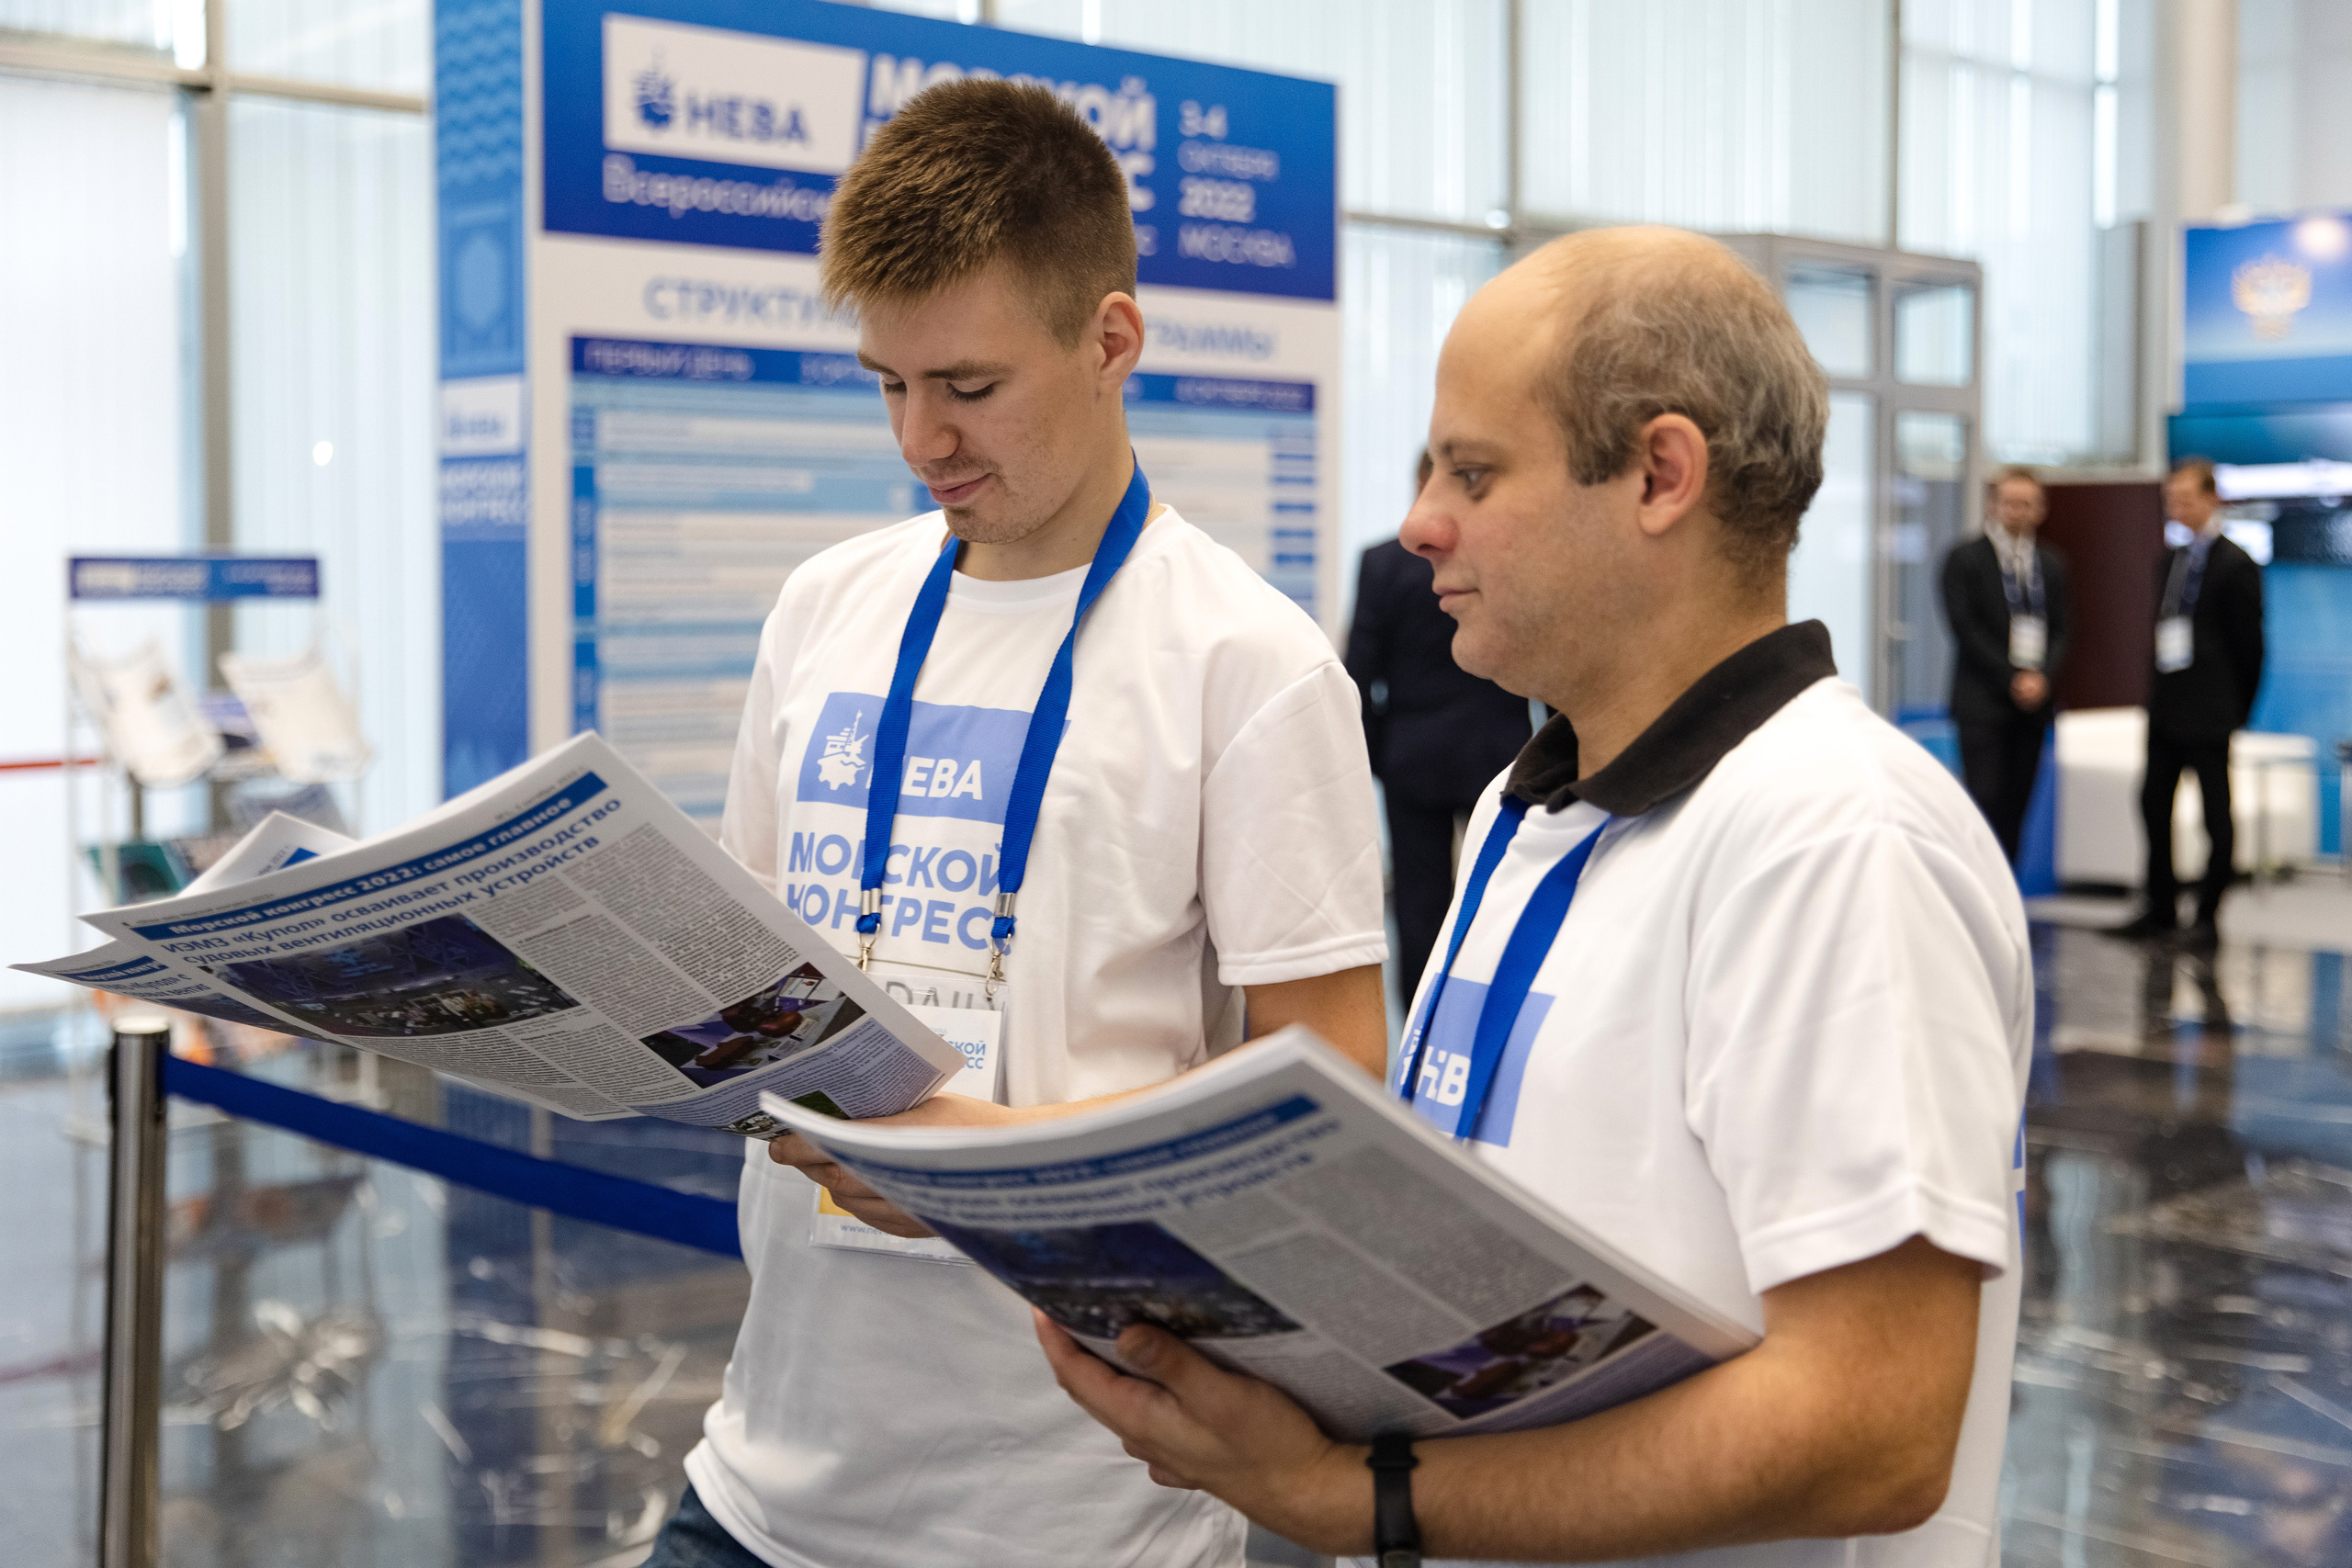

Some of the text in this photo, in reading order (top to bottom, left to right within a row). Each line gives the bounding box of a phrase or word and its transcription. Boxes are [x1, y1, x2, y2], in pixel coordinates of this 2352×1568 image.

[684, 91, 813, 150] НЕВА
[865, 756, 984, 801] ЕВА
[161, 798, 622, 953] ИЭМЗ «Купол» осваивает производство
[168, 911, 263, 935] Морской
[262, 884, 354, 918] конгресс
[355, 865, 420, 894] 2022:
[424, 842, 487, 872] самое
[487, 797, 572, 847] главное
[183, 944, 277, 965] судовых
[277, 891, 477, 952] вентиляционных
[479, 835, 601, 898] устройств
